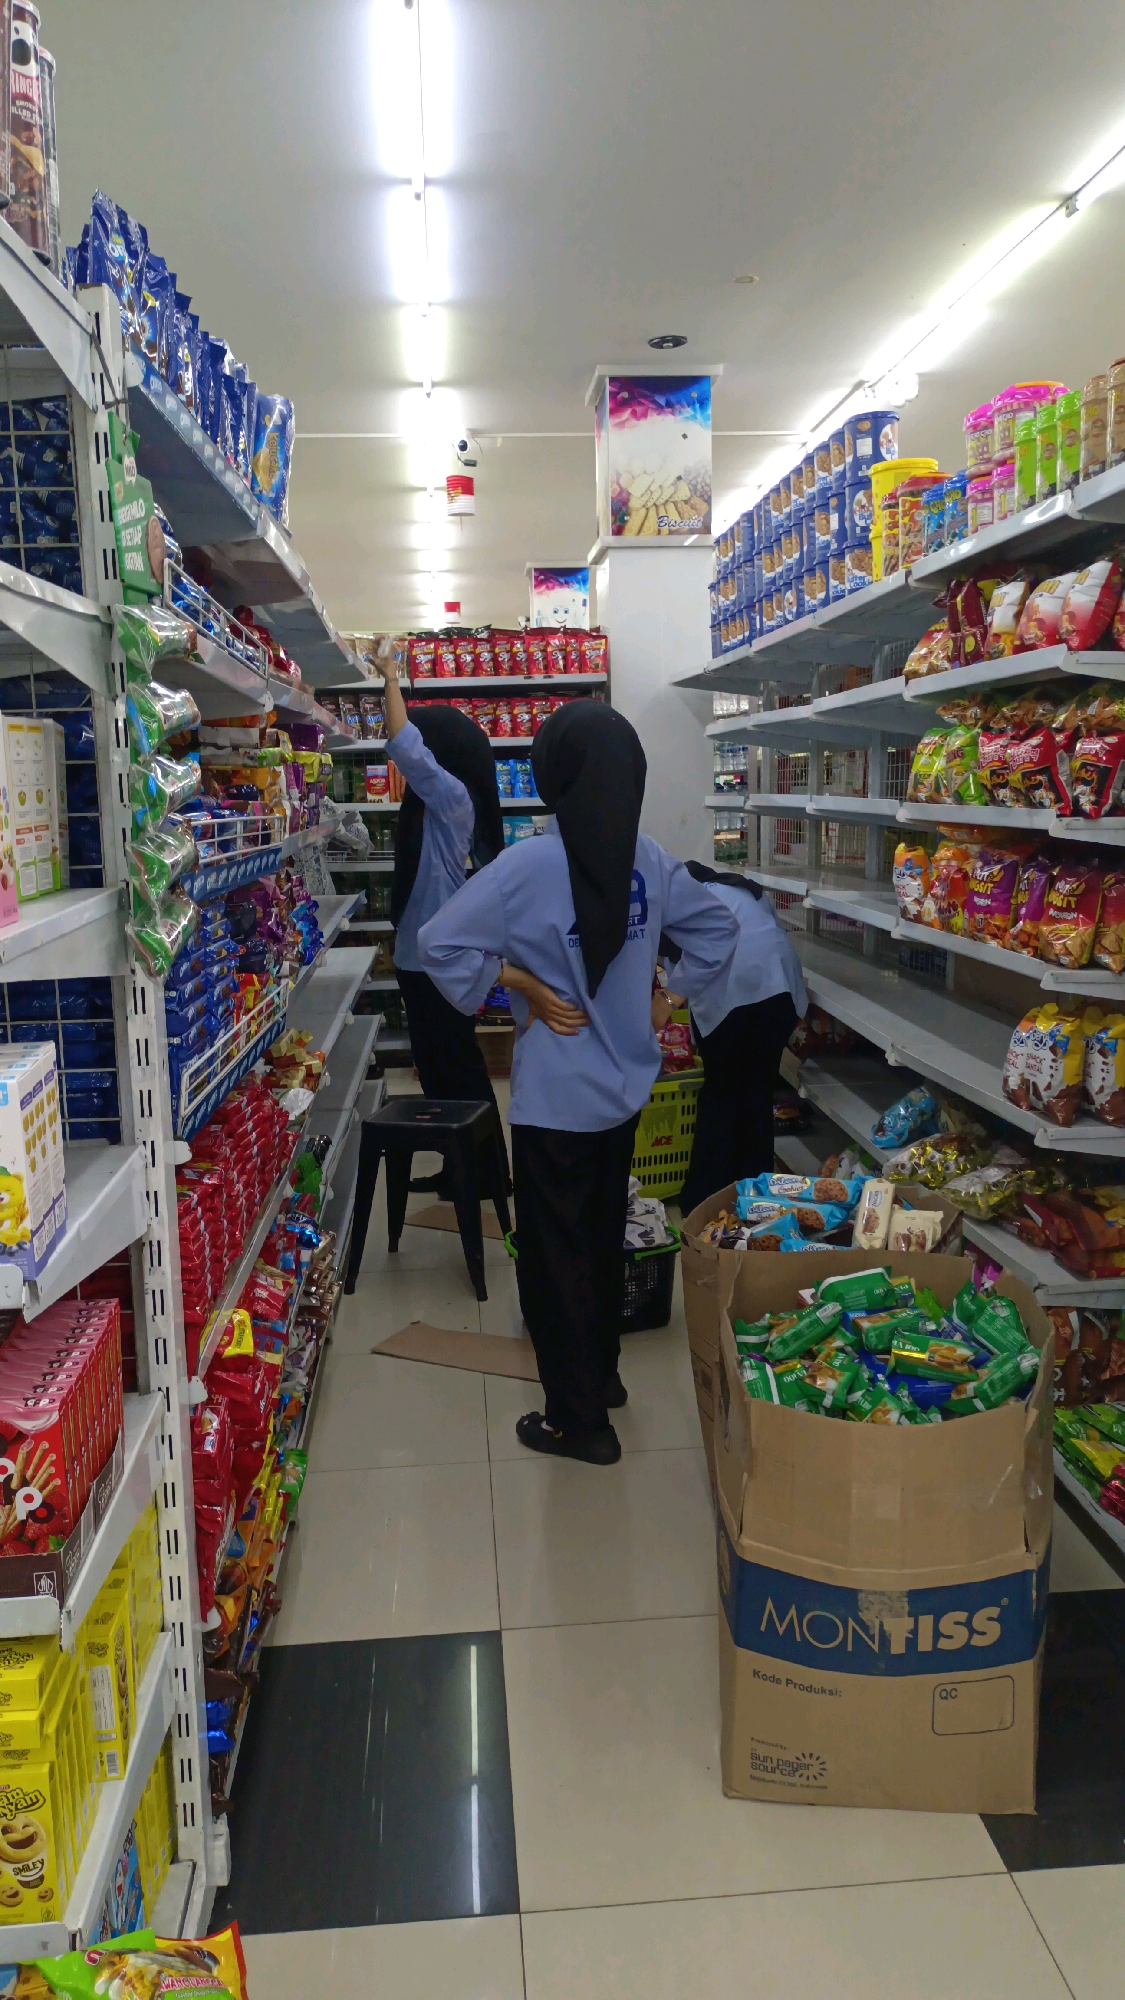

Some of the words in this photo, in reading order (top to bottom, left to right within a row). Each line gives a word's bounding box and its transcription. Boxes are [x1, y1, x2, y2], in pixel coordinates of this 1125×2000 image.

[657, 515, 703, 528] Biscuit
[1027, 1053, 1043, 1067] SNACK
[651, 1135, 674, 1147] ACE
[778, 1186, 804, 1194] Cookies
[759, 1596, 1002, 1655] MONTISS
[752, 1668, 782, 1685] Kode
[786, 1679, 842, 1697] Produksi:
[939, 1688, 958, 1700] QC
[750, 1761, 796, 1777] source
[751, 1752, 774, 1764] sun
[776, 1758, 813, 1773] paper
